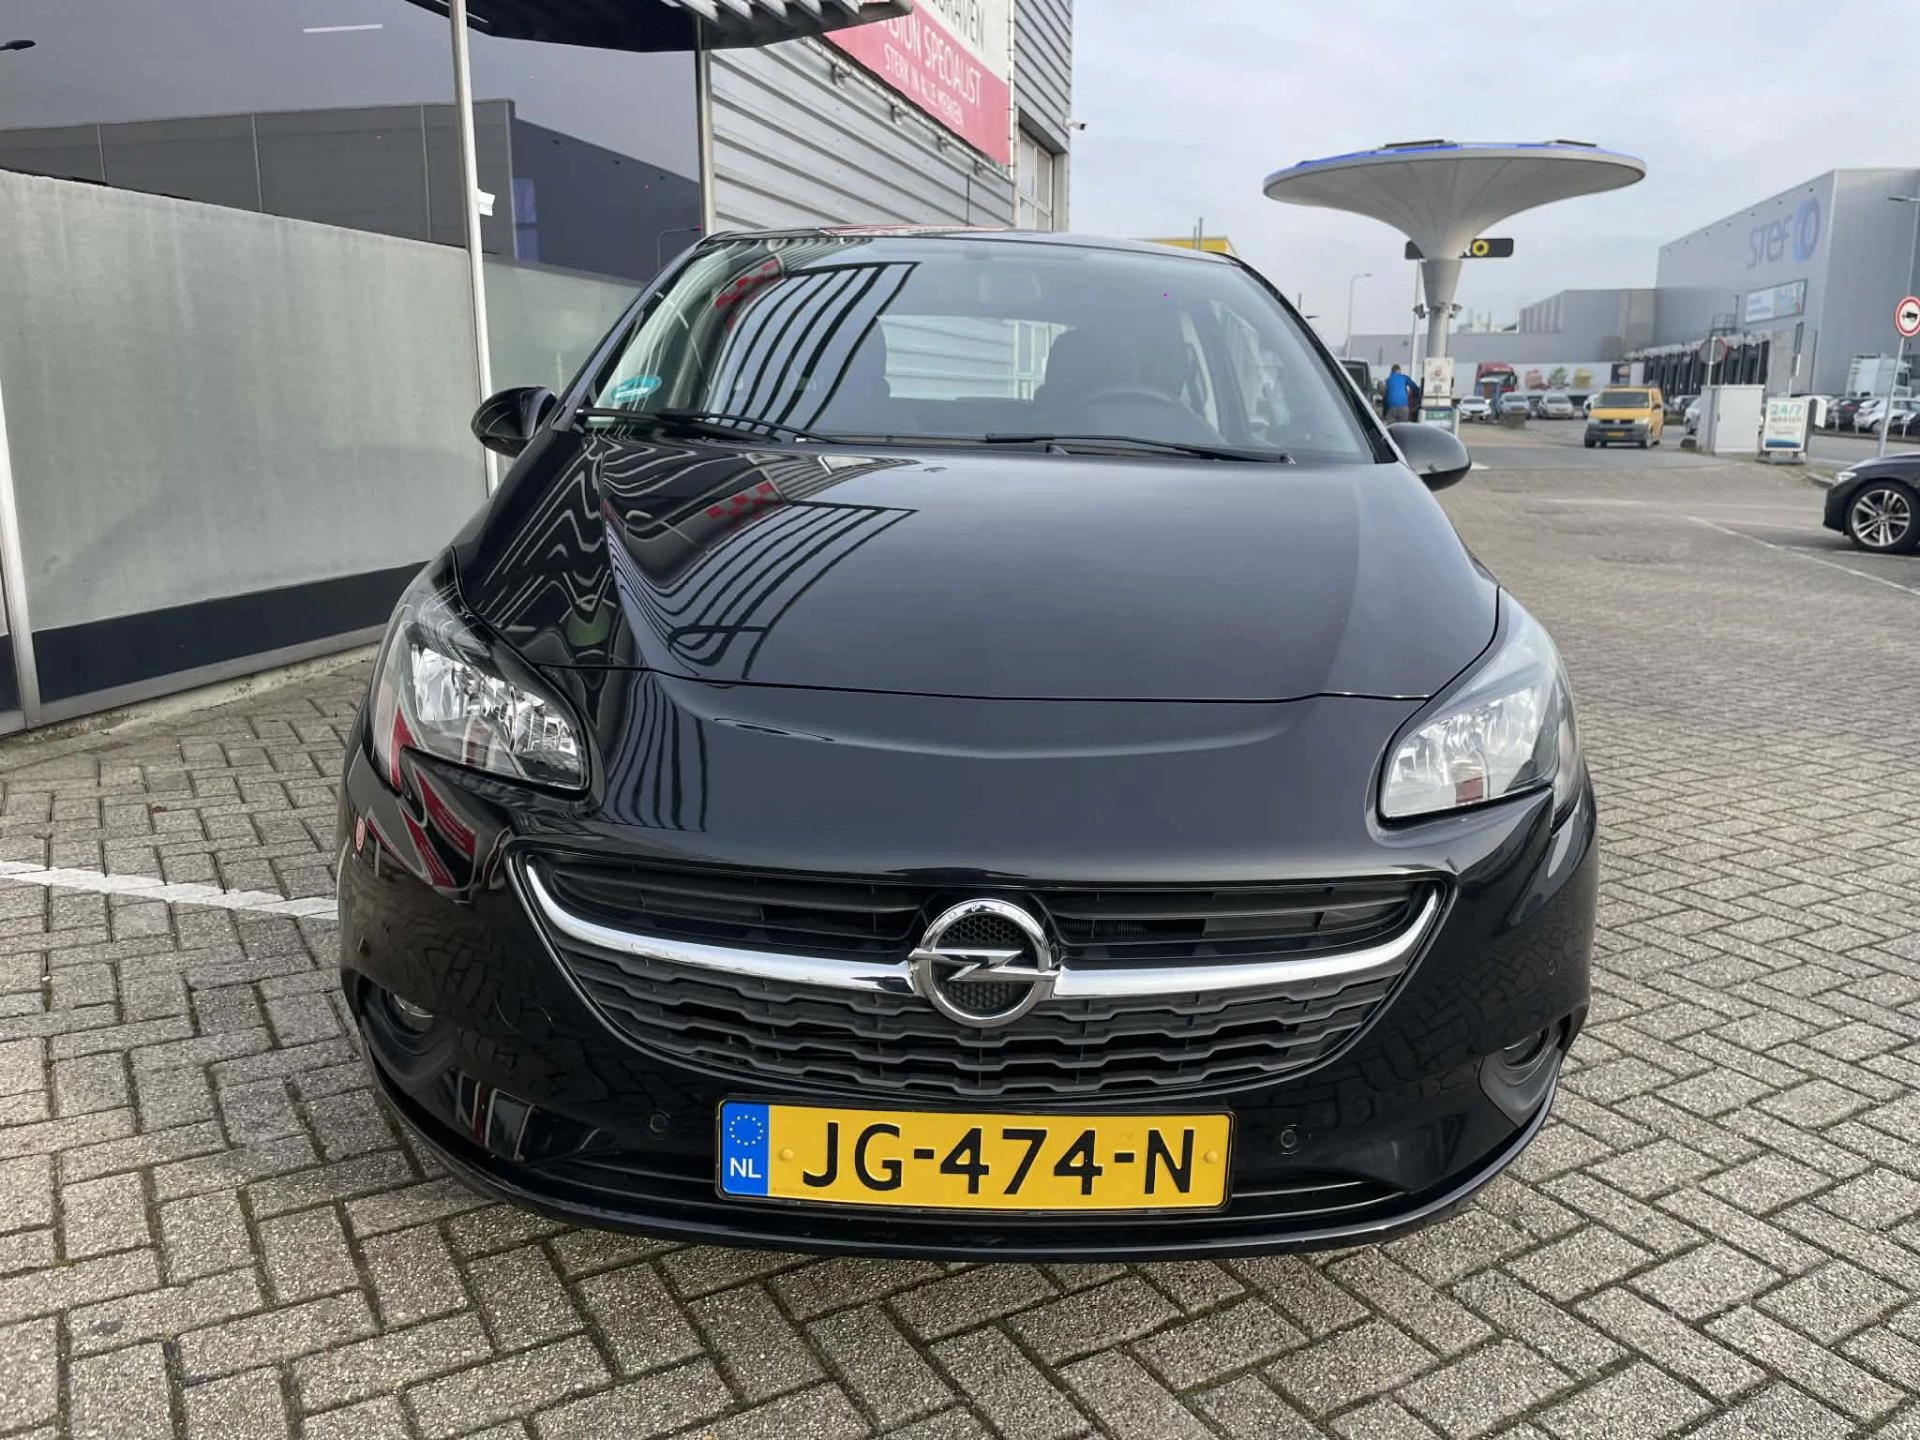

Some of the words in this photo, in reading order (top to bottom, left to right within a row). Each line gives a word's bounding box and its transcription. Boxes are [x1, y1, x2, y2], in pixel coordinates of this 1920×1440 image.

[924, 25, 981, 108] SPECIALIST
[730, 1157, 762, 1179] NL
[802, 1121, 1195, 1196] JG-474-N
